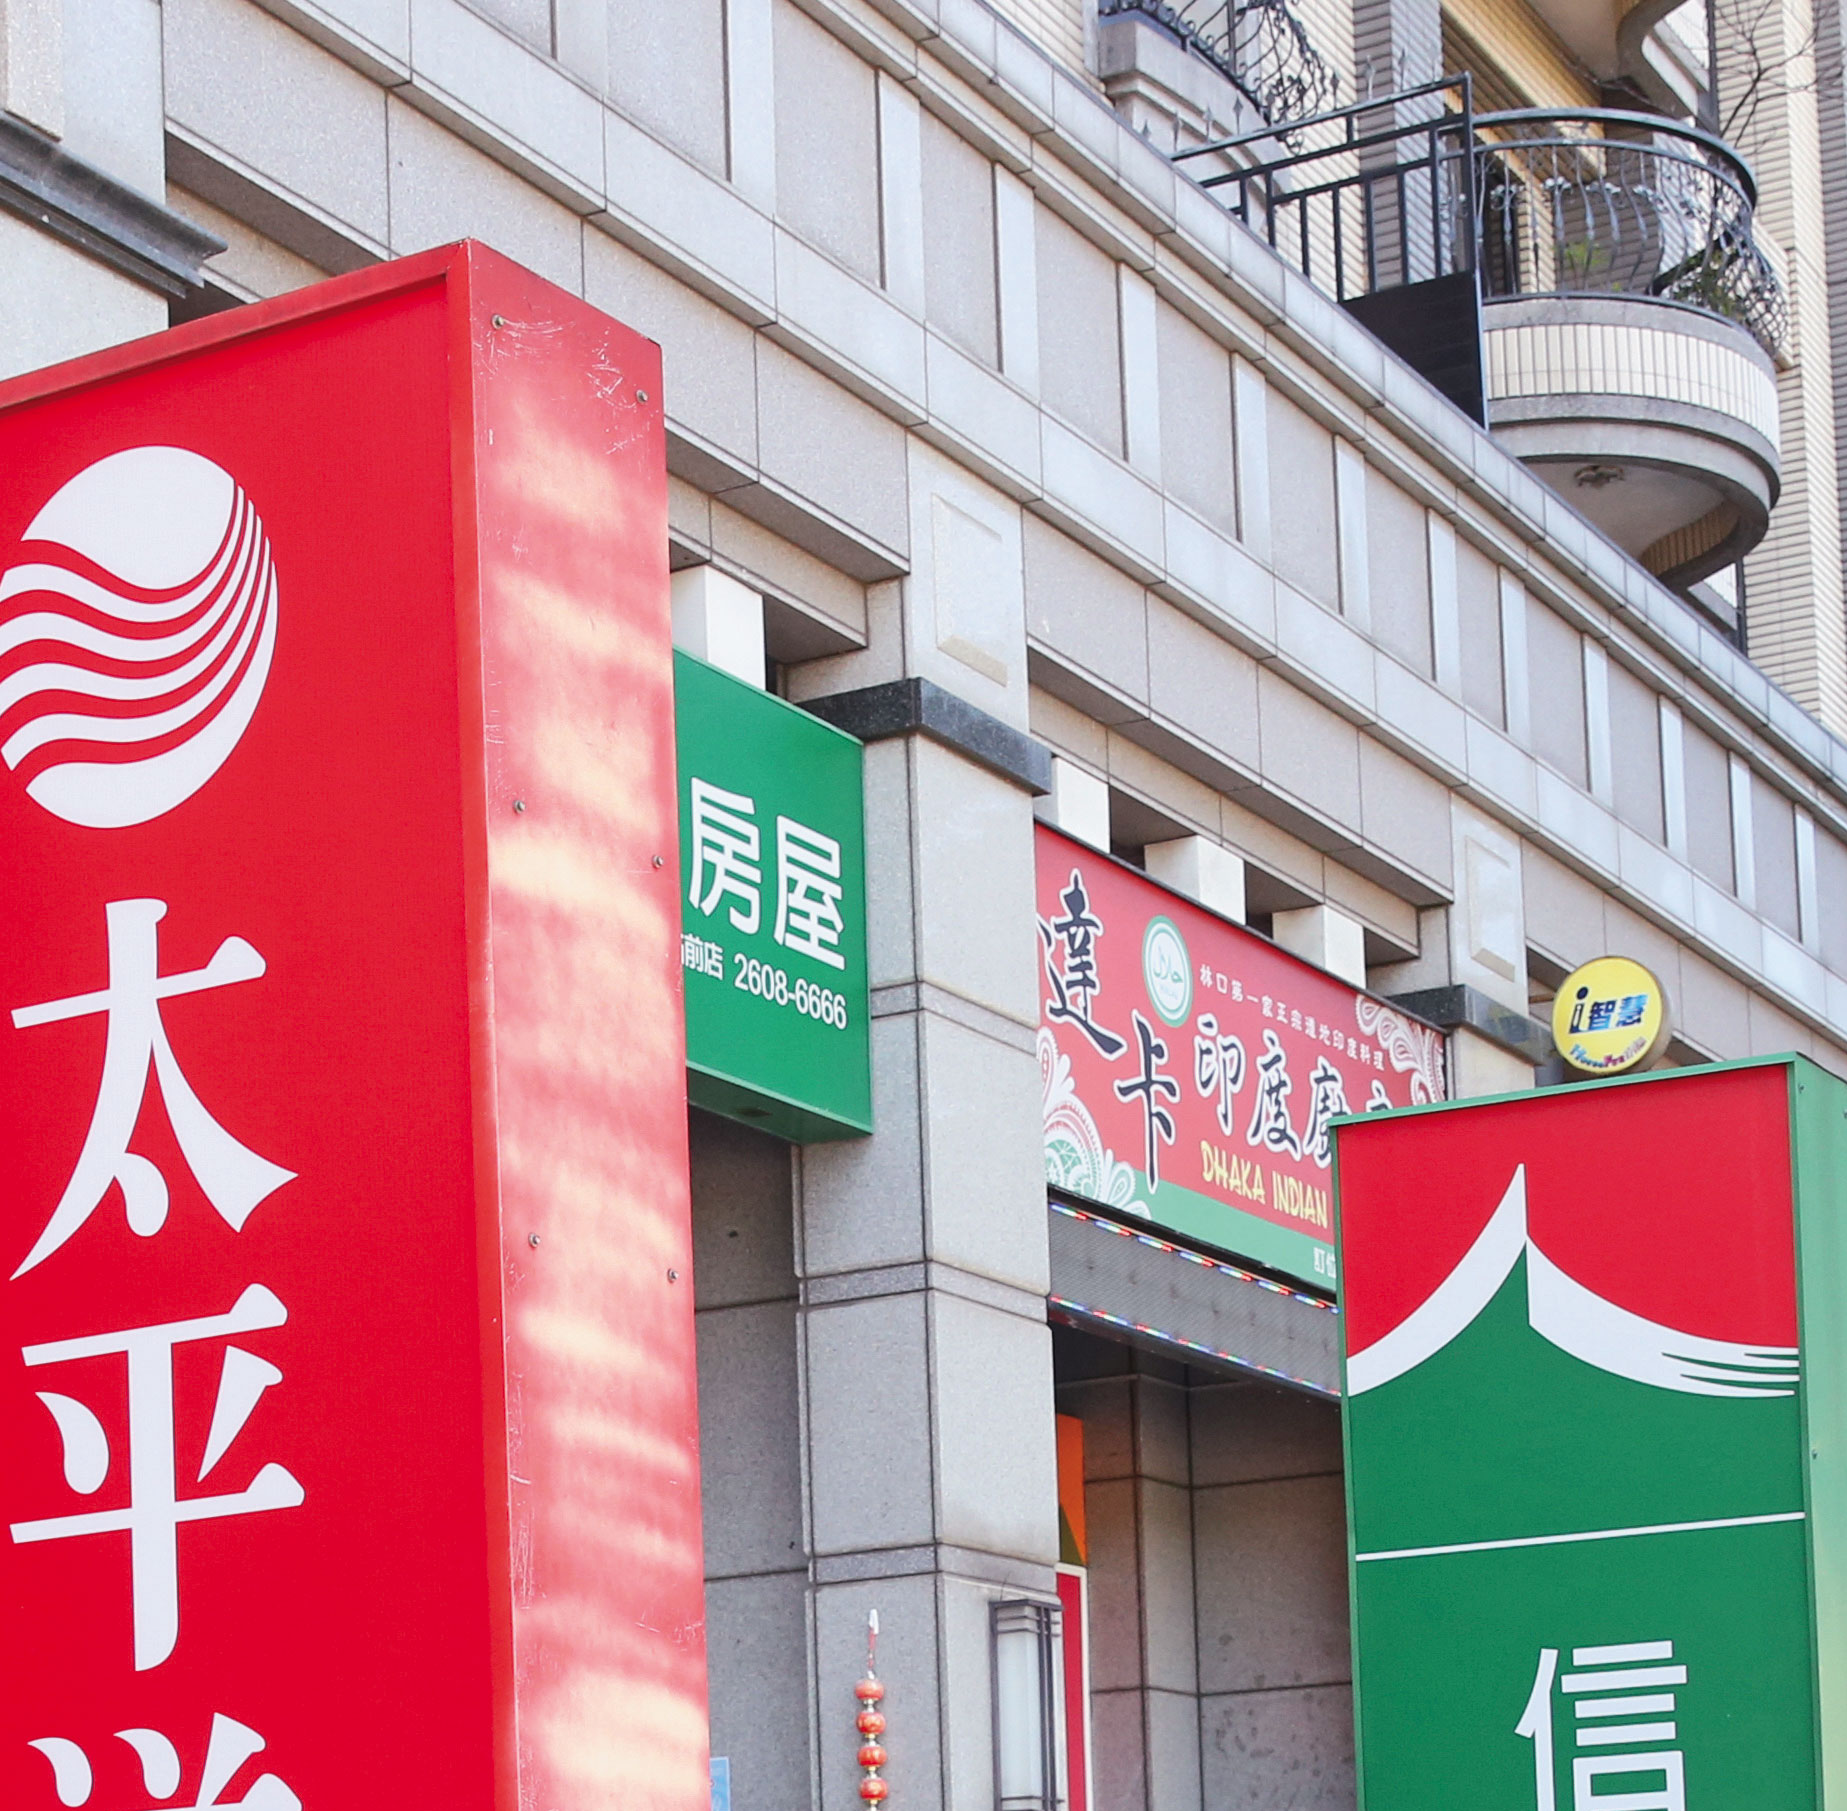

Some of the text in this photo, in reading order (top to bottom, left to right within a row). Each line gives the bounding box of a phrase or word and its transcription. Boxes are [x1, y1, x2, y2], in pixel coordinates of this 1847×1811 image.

[689, 777, 845, 970] 房屋
[681, 932, 847, 1030] 前店 2608-6666
[1200, 1140, 1329, 1230] DHAKA INDIAN
